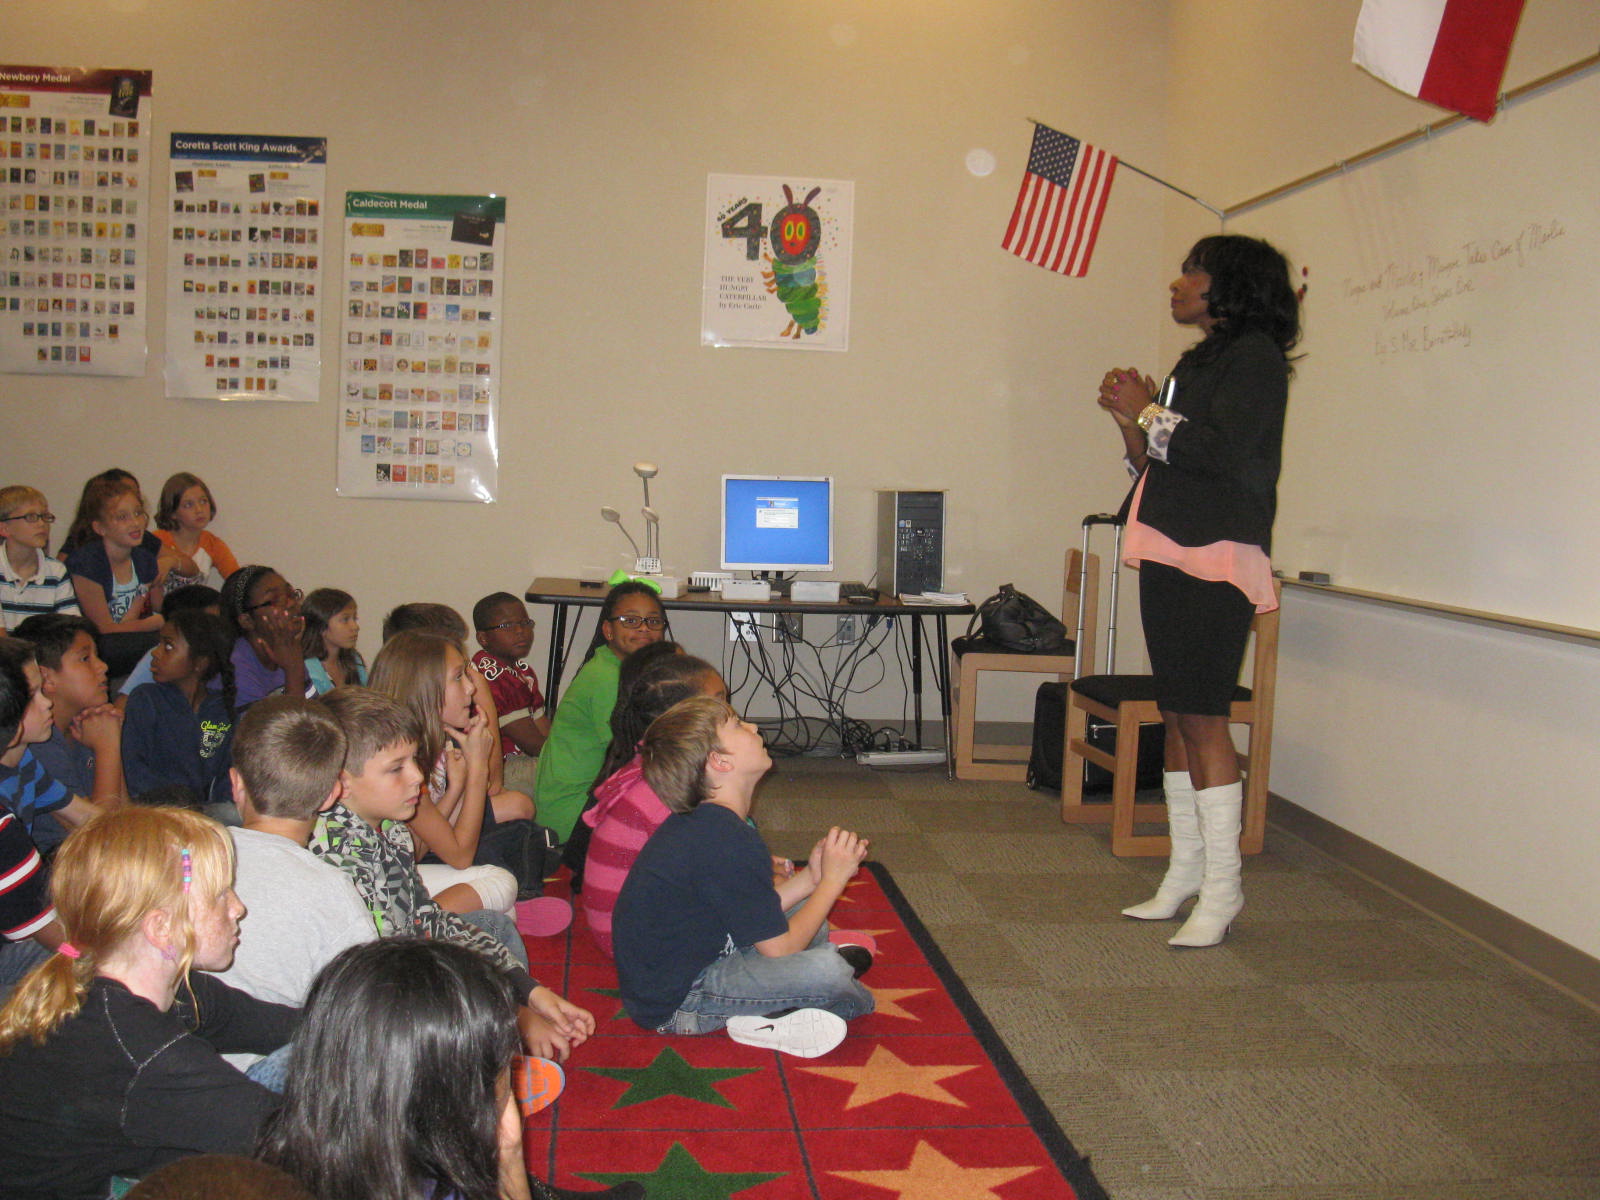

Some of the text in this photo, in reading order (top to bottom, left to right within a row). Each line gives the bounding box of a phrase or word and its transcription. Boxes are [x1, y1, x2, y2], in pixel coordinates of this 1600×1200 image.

[0, 72, 71, 83] Newbery Medal
[175, 140, 297, 154] Coretta Scott King Awards
[352, 198, 428, 209] Caldecott Medal
[720, 275, 733, 283] THE
[719, 293, 767, 301] CATERPILLAR
